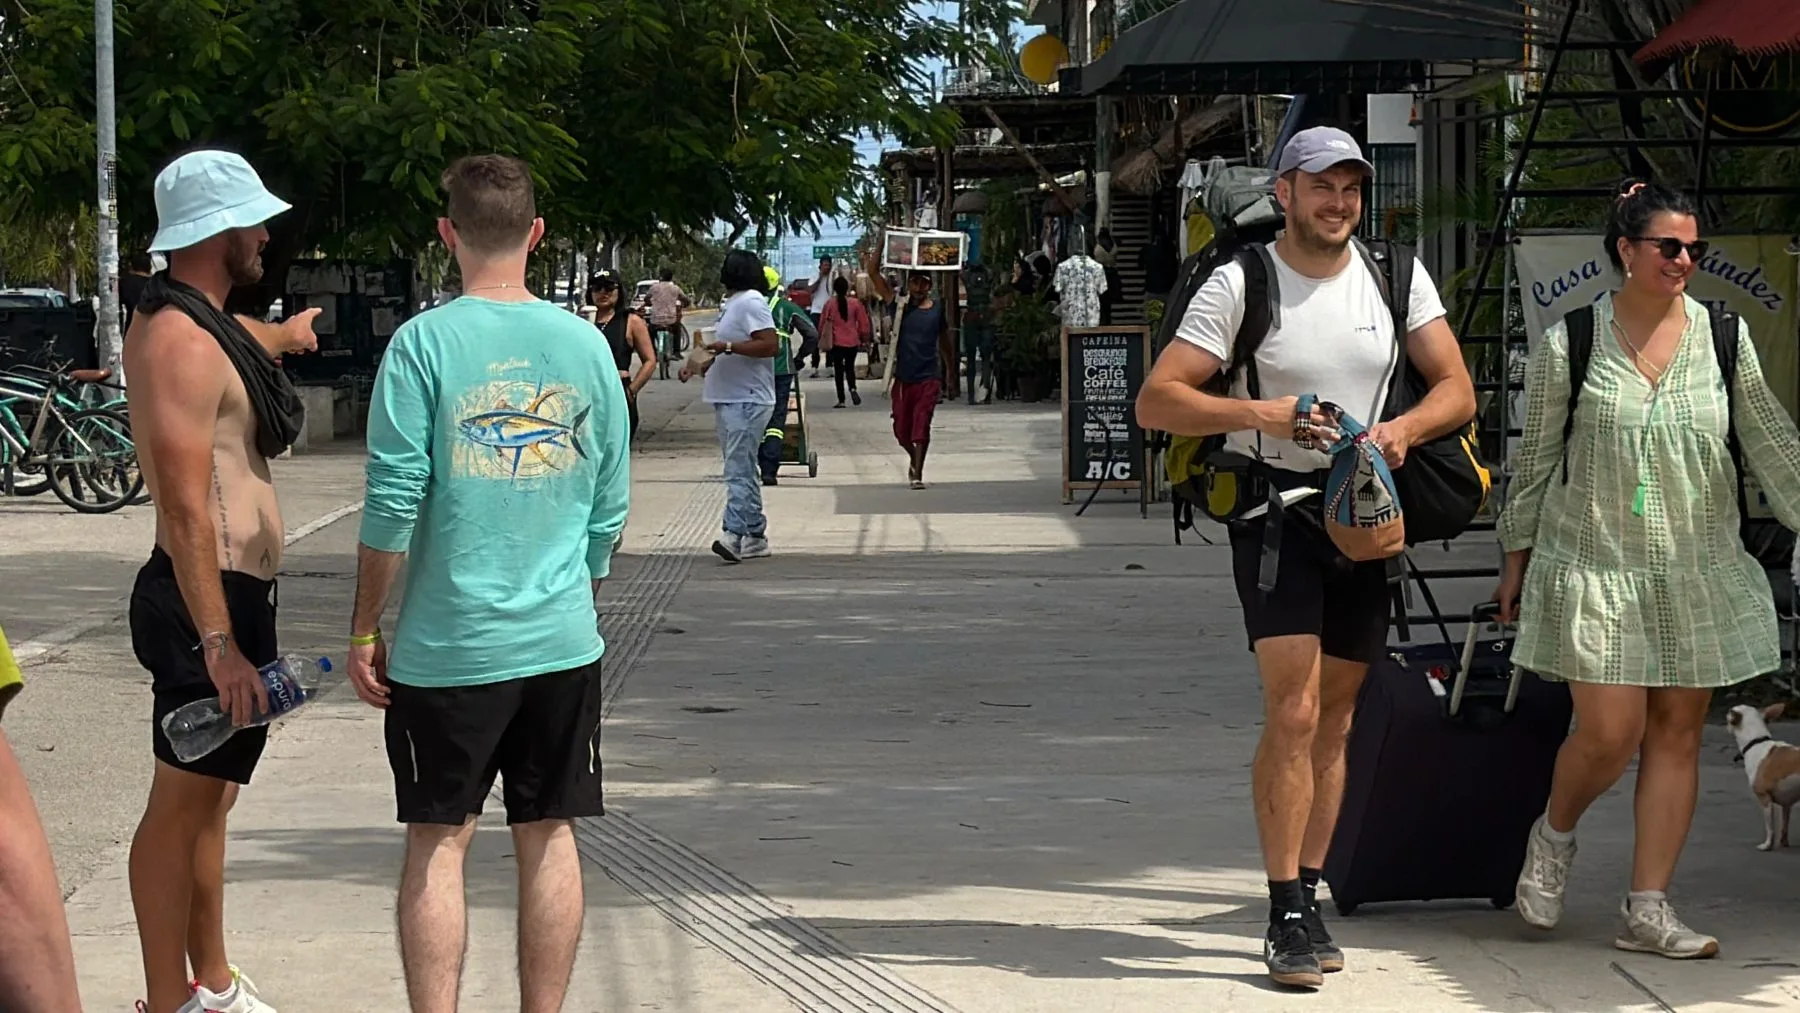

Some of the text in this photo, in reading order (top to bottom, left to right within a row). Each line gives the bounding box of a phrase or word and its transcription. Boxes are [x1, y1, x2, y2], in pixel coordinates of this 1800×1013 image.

[1532, 250, 1785, 310] Casa ández
[1084, 365, 1125, 380] Café
[1083, 379, 1128, 388] COFFEE
[1085, 461, 1131, 480] A/C
